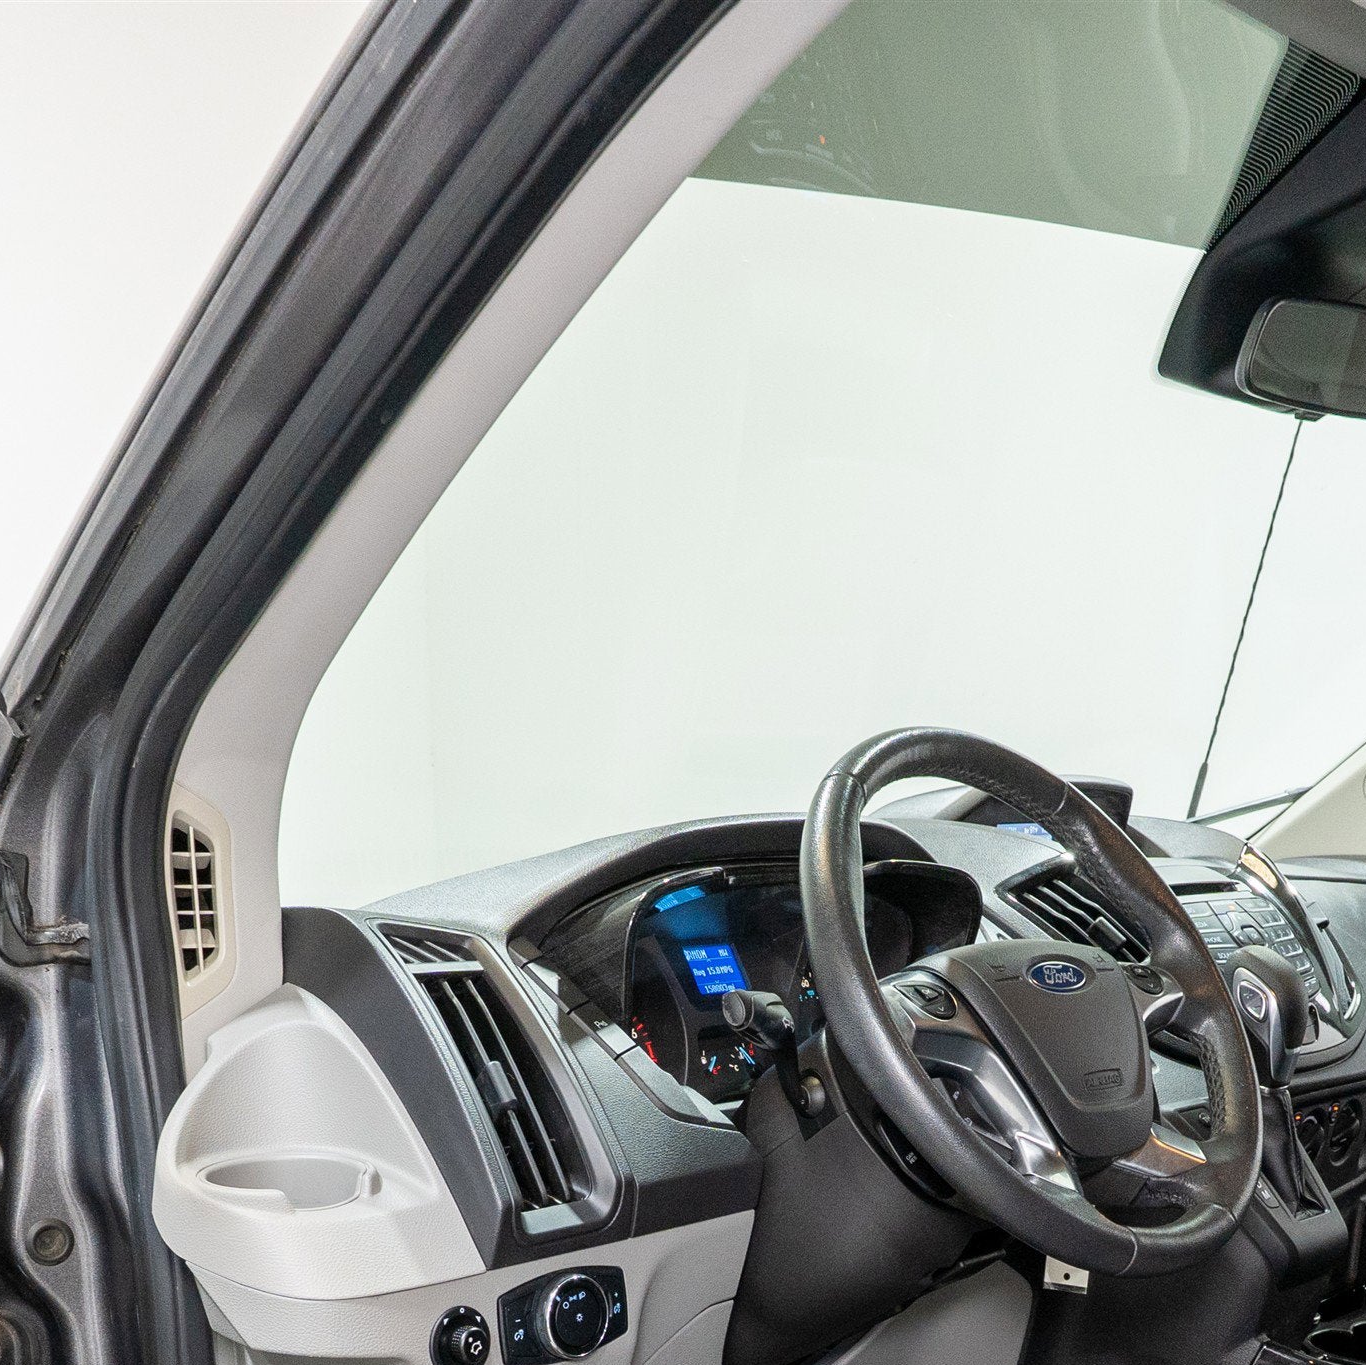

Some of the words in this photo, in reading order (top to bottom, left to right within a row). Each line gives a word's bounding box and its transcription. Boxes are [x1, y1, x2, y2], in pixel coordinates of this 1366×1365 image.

[693, 968, 707, 977] Avg
[1042, 963, 1078, 983] Ford
[631, 1028, 638, 1039] 6
